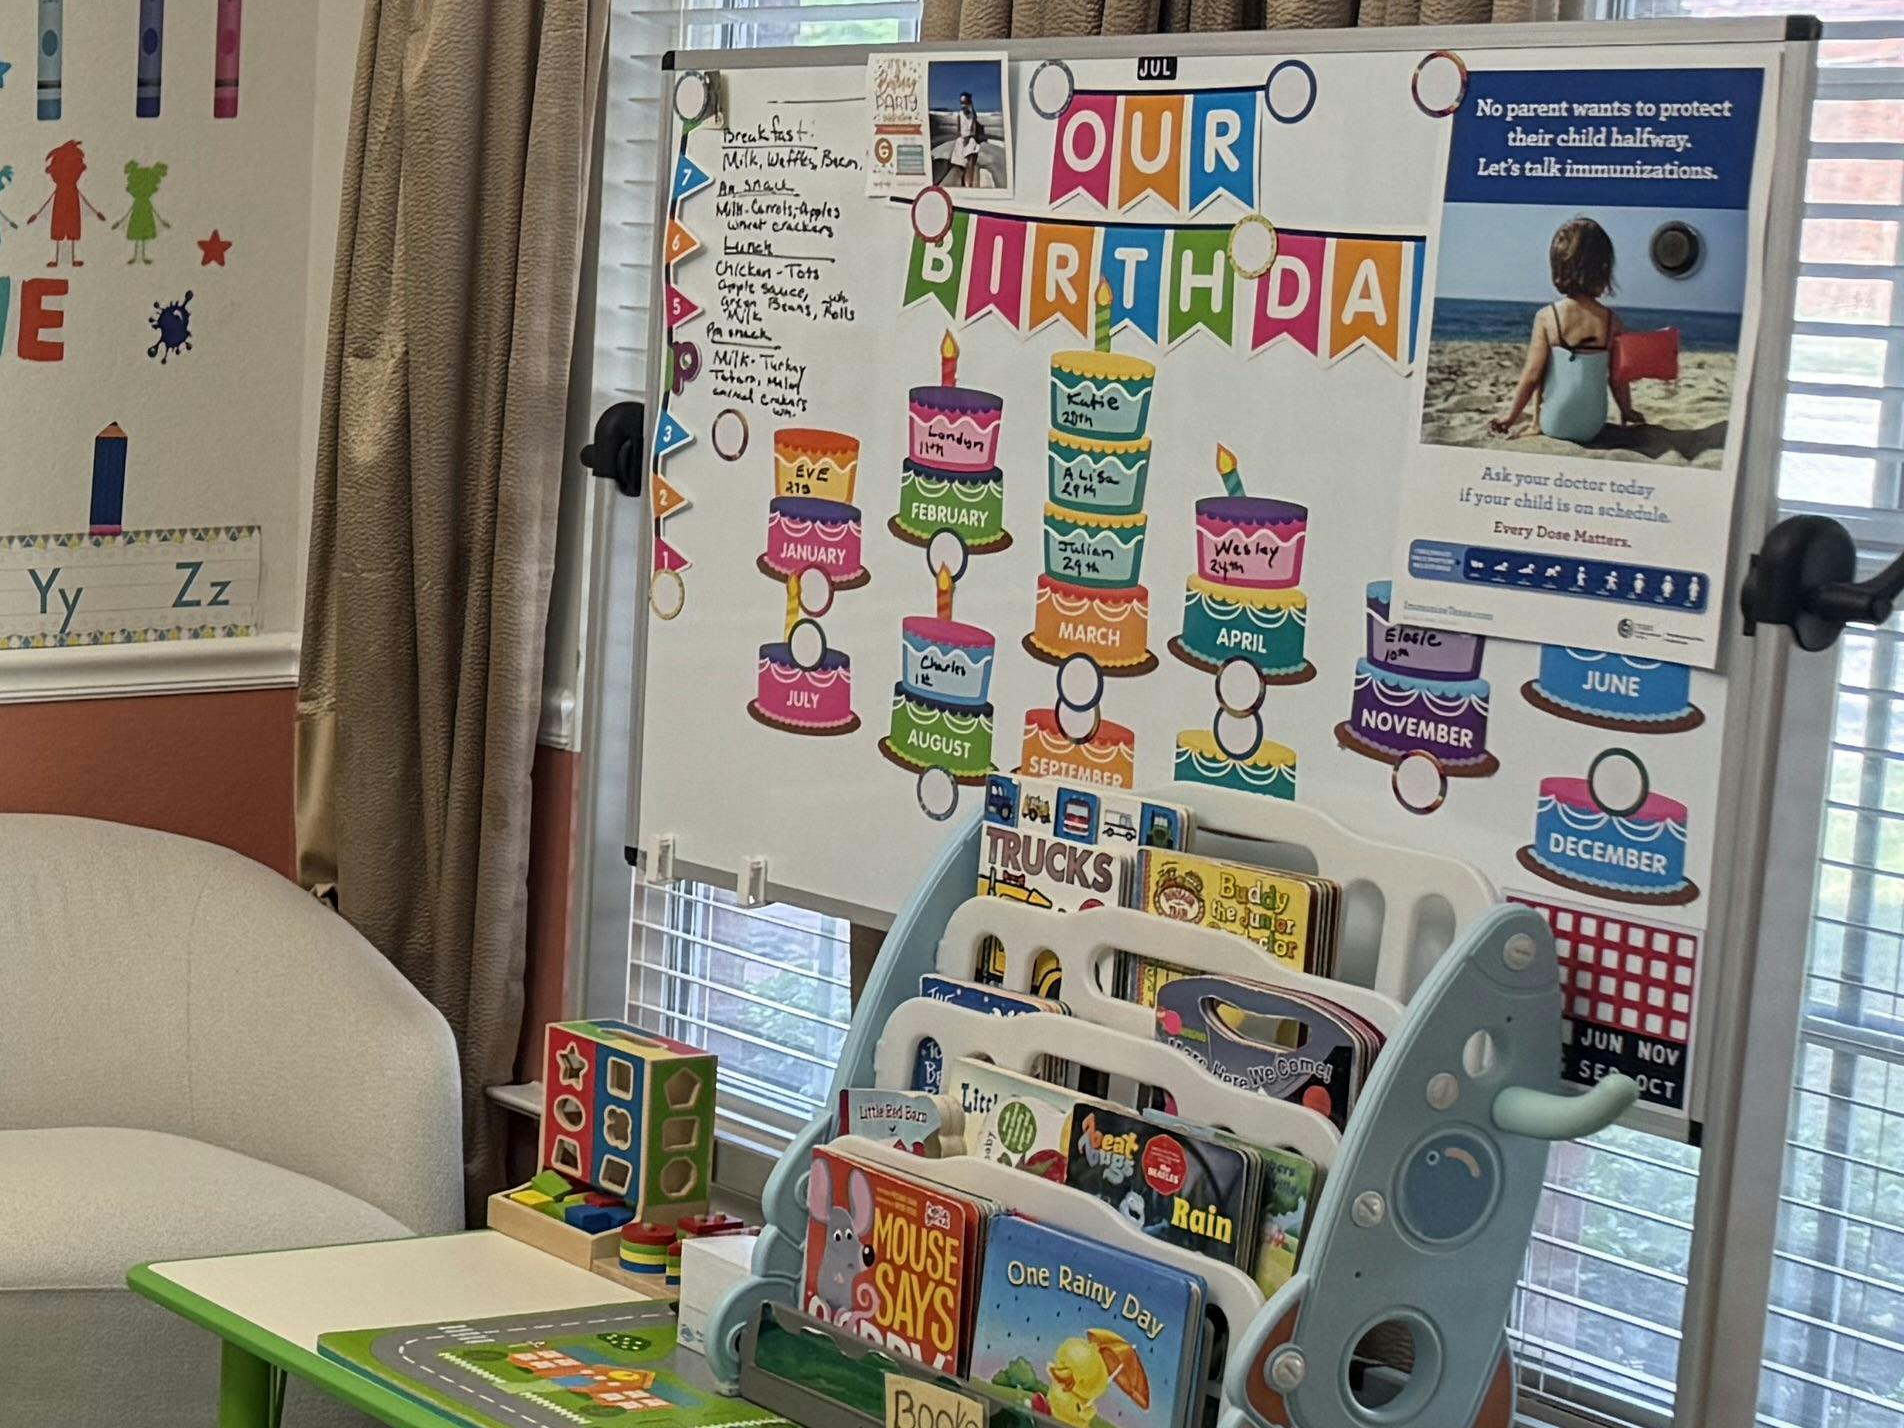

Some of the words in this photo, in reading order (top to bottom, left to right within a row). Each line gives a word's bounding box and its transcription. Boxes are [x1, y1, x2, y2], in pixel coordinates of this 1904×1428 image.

[1140, 58, 1171, 78] JUL
[1477, 98, 1503, 116] No
[1506, 99, 1568, 121] parent
[1573, 101, 1630, 118] wants
[1636, 101, 1654, 118] to
[1659, 98, 1732, 124] protect
[1061, 109, 1242, 175] OUR
[1508, 129, 1552, 147] their
[1557, 130, 1605, 148] child
[1610, 130, 1692, 152] halfway.
[1478, 157, 1520, 177] Let's
[1525, 159, 1561, 177] talk
[1566, 161, 1717, 180] immunizations.
[1068, 393, 1120, 411] Katie
[796, 465, 830, 481] EVE
[911, 502, 989, 527] FEBRUARY
[1494, 522, 1533, 540] Every
[1536, 527, 1570, 542] Dose
[1574, 531, 1632, 548] Matters.
[781, 543, 846, 564] JANUARY
[1059, 541, 1114, 560] Julian
[1214, 541, 1279, 568] Wesley
[173, 562, 231, 609] Zz
[1059, 622, 1120, 646] MARCH
[1216, 628, 1267, 653] APRIL
[1583, 670, 1640, 697] JUNE
[787, 691, 819, 708] JULY
[1361, 708, 1473, 749] NOVEMBER
[908, 729, 971, 758] AUGUST
[1028, 754, 1124, 788] SEPTEMBER
[986, 826, 1113, 893] TRUCKS
[1550, 833, 1668, 875] DECEMBER
[1219, 872, 1290, 915] Buddy
[1212, 898, 1236, 922] the
[1240, 908, 1296, 935] Junior
[1170, 1196, 1233, 1245] Rain
[874, 1207, 959, 1285] MOUSE
[875, 1262, 955, 1352] SAYS
[1007, 1260, 1050, 1290] One
[1056, 1263, 1118, 1313] Rainy
[1123, 1293, 1165, 1340] Day
